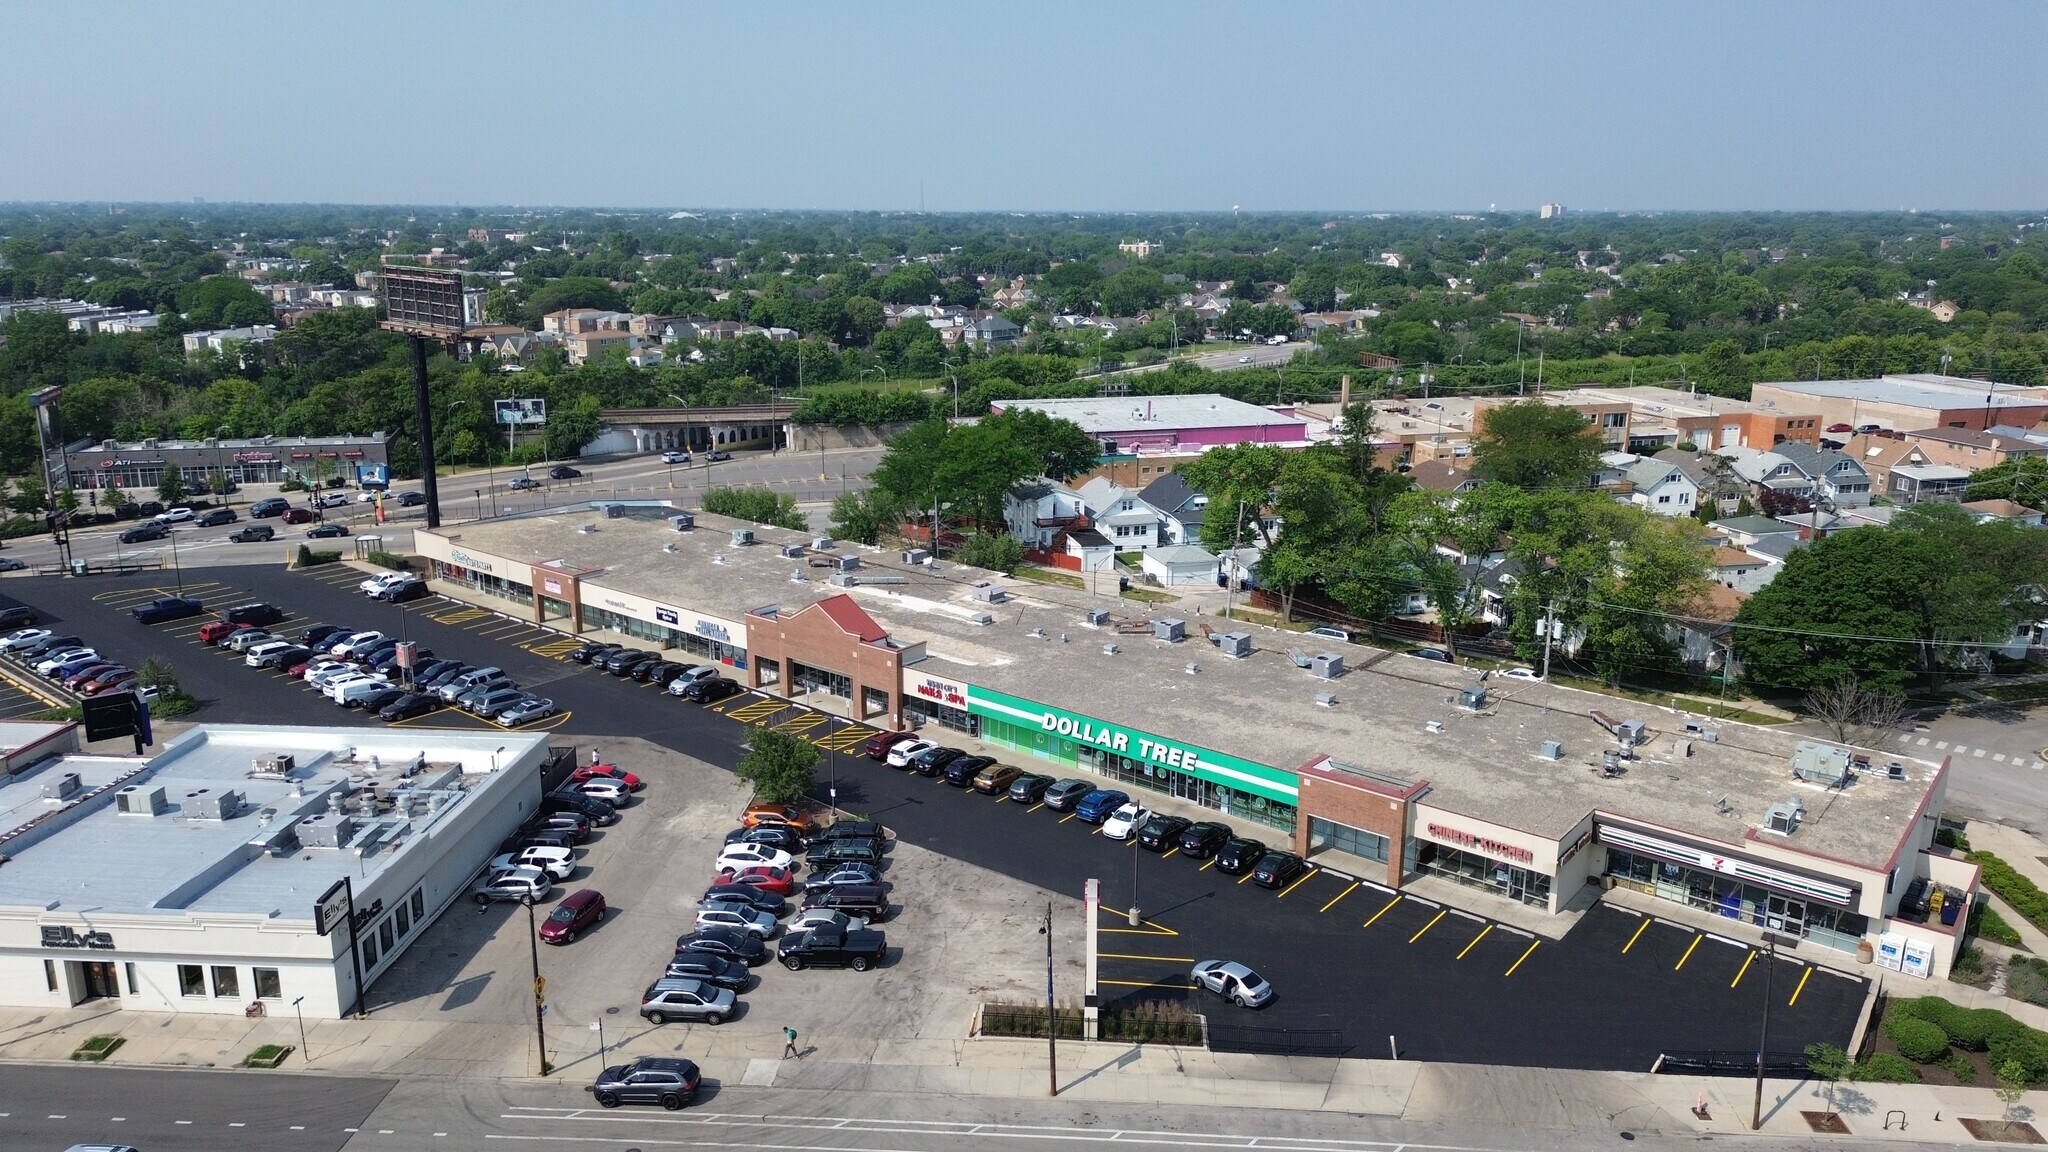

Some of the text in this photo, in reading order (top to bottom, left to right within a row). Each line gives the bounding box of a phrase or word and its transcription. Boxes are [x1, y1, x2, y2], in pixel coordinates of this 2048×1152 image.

[917, 684, 943, 700] NAILS
[947, 692, 966, 707] SPA
[1041, 711, 1199, 772] DOLLAR TREE
[1427, 823, 1477, 848] CHINESE
[1480, 837, 1534, 864] KITCHEN
[323, 896, 348, 921] Elly's
[40, 925, 113, 948] Elly's
